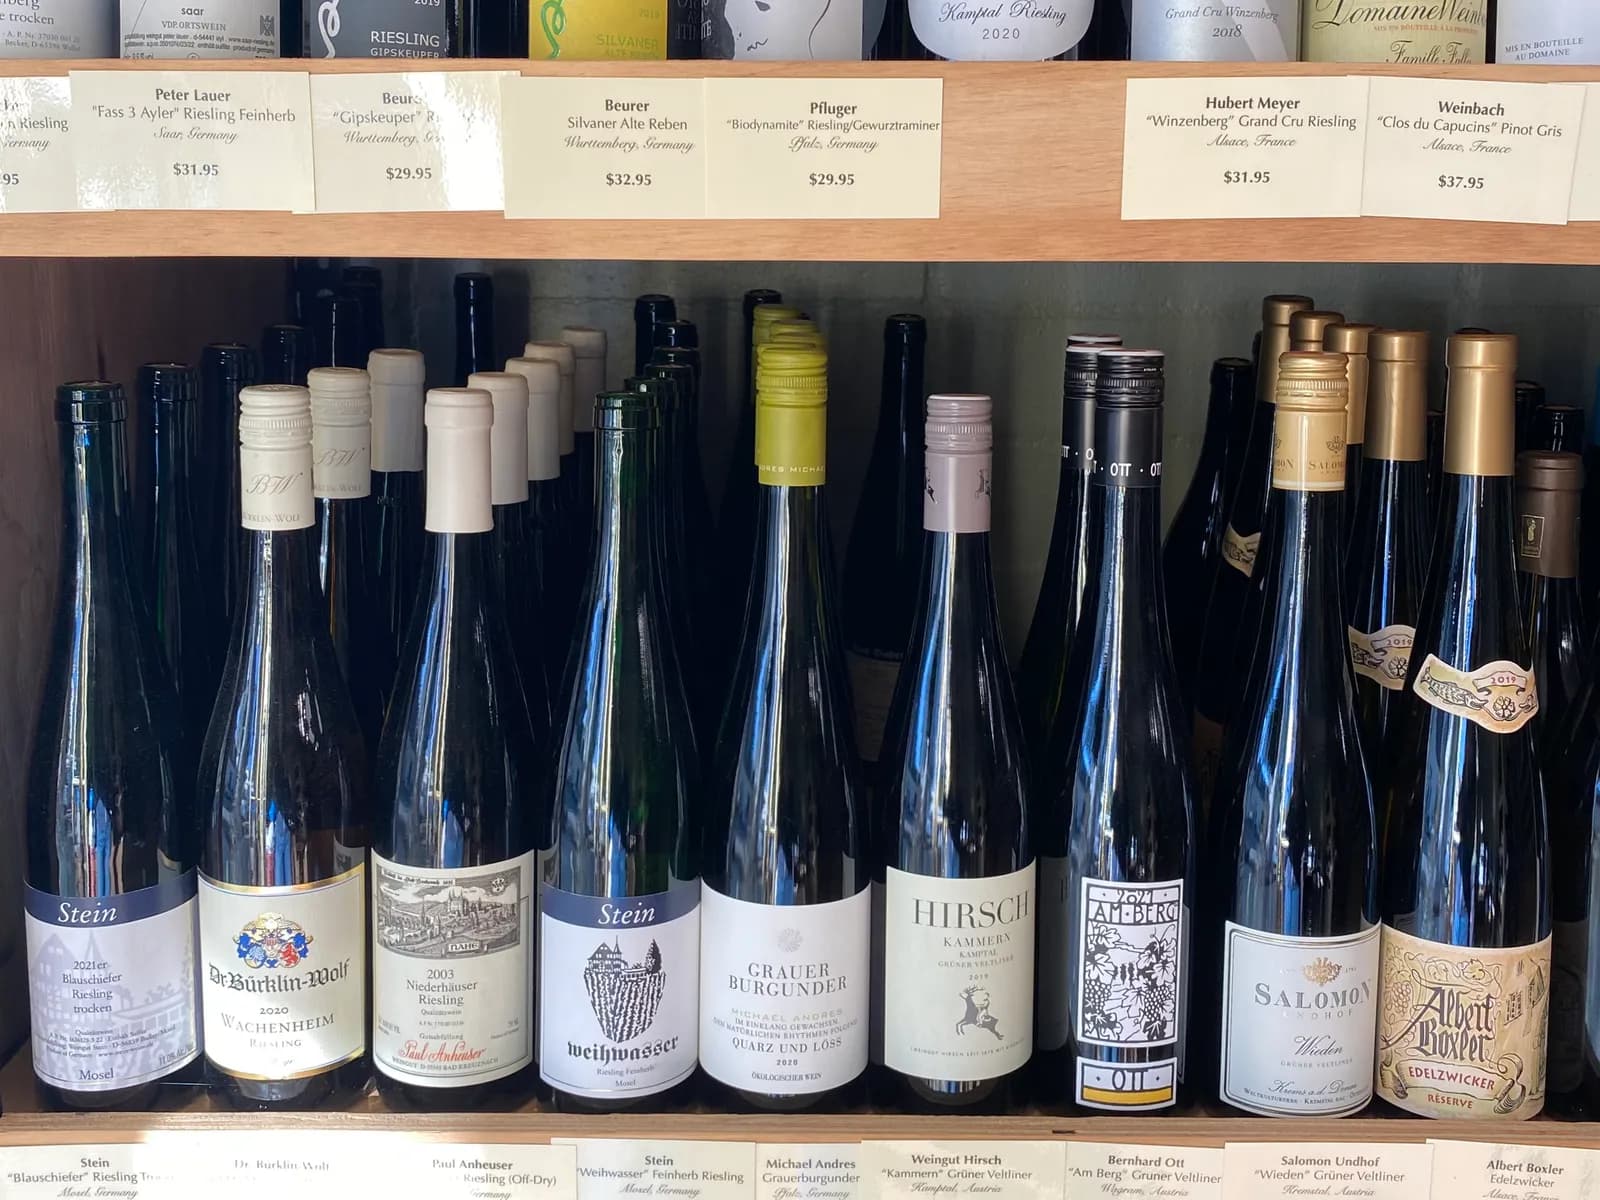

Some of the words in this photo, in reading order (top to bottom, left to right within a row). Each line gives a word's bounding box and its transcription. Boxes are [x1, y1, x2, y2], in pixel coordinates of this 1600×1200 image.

[10, 12, 54, 24] trocken
[181, 7, 204, 16] saar
[938, 1, 1003, 24] Kamptal
[1009, 0, 1066, 27] Riesling
[1165, 6, 1200, 19] Grand
[1202, 6, 1222, 17] Cru
[1225, 6, 1279, 24] Winzenberg
[1312, 0, 1439, 30] Domaine
[982, 28, 1020, 40] 2020
[1212, 24, 1242, 38] 2018
[370, 31, 440, 47] RIESLING
[595, 33, 658, 50] SILVANER
[1505, 44, 1518, 53] MIS
[1520, 42, 1532, 51] EN
[1534, 38, 1584, 49] BOUTEILLE
[1528, 48, 1570, 60] DOMAINE
[156, 88, 189, 101] Peter
[194, 89, 231, 102] Lauer
[605, 99, 650, 112] Beurer
[810, 102, 858, 118] Pfluger
[1206, 96, 1253, 110] Hubert
[1258, 97, 1301, 113] Meyer
[1438, 100, 1505, 116] Weinbach
[92, 106, 124, 118] "Fass
[128, 106, 136, 118] 3
[140, 106, 179, 122] Ayler"
[184, 107, 235, 124] Riesling
[240, 108, 296, 122] Feinherb
[333, 110, 421, 127] “Gipskeuper”
[567, 116, 617, 129] Silvaner
[620, 117, 645, 130] Alte
[649, 117, 688, 130] Reben
[726, 119, 804, 132] “Biodynamite”
[807, 120, 940, 134] Riesling/Gewurztraminer
[1146, 115, 1234, 130] “Winzenberg”
[1238, 115, 1278, 128] Grand
[1281, 115, 1304, 128] Cru
[1308, 115, 1357, 131] Riesling
[1377, 116, 1410, 129] “Clos
[1414, 118, 1430, 130] du
[1434, 119, 1498, 134] Capucins”
[1500, 122, 1533, 136] Pinot
[1536, 124, 1562, 138] Gris
[187, 127, 238, 144] Germany
[1206, 134, 1250, 148] Alsace,
[1254, 134, 1297, 147] France
[643, 136, 695, 154] Germany
[826, 136, 878, 153] Germany
[1422, 138, 1465, 152] Alsace,
[1469, 139, 1513, 154] France
[173, 162, 219, 176] $31.95
[386, 168, 432, 180] $29.95
[606, 172, 652, 186] $32.95
[809, 173, 855, 186] $29.95
[1224, 170, 1270, 184] $31.95
[1438, 174, 1484, 190] $37.95
[1110, 462, 1132, 477] OTT
[1386, 638, 1412, 647] 2019
[1490, 676, 1517, 686] 2019
[58, 902, 118, 924] Stein
[598, 902, 656, 924] Stein
[912, 890, 1030, 929] HIRSCH
[944, 933, 1010, 948] KAMMERN
[73, 960, 108, 970] 2021er
[748, 962, 830, 980] GRAUER
[62, 974, 122, 985] Blauschiefer
[427, 968, 455, 980] 2003
[406, 980, 478, 992] Niederhäuser
[728, 974, 848, 997] BURGUNDER
[72, 989, 113, 1000] Riesling
[418, 994, 464, 1006] Riesling
[1255, 980, 1370, 1010] SALOMON
[73, 1004, 112, 1014] trocken
[260, 1006, 289, 1015] 2020
[732, 1008, 786, 1022] MICHAEL
[792, 1008, 844, 1022] ANDRES
[221, 1013, 334, 1034] WACHENHEIM
[736, 1018, 746, 1026] IM
[790, 1018, 838, 1030] GEWACHSEN
[732, 1037, 774, 1053] QUARZ
[780, 1044, 808, 1054] UND
[813, 1037, 842, 1052] LÖSS
[1293, 1036, 1344, 1056] Wieden
[1412, 1018, 1495, 1063] Boxler
[398, 1040, 429, 1060] Paul
[568, 1036, 679, 1066] weihwasser
[79, 1068, 114, 1080] Mosel
[597, 1068, 624, 1077] Riesling
[804, 1072, 822, 1081] WEIN
[1112, 1068, 1148, 1091] OTT
[1408, 1066, 1495, 1091] EDELZWICKER
[80, 1157, 110, 1168] Stein
[432, 1160, 455, 1168] Paul
[459, 1160, 513, 1170] Anheuser
[644, 1155, 674, 1166] Stein
[766, 1158, 812, 1169] Michael
[815, 1158, 856, 1169] Andres
[912, 1154, 960, 1167] Weingut
[964, 1154, 1002, 1166] Hirsch
[1108, 1154, 1162, 1167] Bernhard
[1164, 1157, 1185, 1168] Ott
[1280, 1156, 1331, 1166] Salomon
[1335, 1156, 1380, 1167] Undhof
[1486, 1160, 1522, 1172] Albert
[1526, 1162, 1564, 1175] Boxler
[92, 1172, 138, 1184] Riesling
[464, 1174, 506, 1186] Riesling
[508, 1174, 556, 1188] (Off-Dry)
[652, 1169, 698, 1181] Feinherb
[702, 1170, 744, 1184] Riesling
[762, 1172, 860, 1186] Grauerburgunder
[946, 1168, 985, 1180] Grüner
[988, 1168, 1032, 1180] Veltliner
[1174, 1171, 1222, 1184] Veltliner
[1314, 1170, 1354, 1181] Grüner
[1356, 1170, 1405, 1182] Veltliner
[1490, 1174, 1554, 1188] Edelzwicker
[94, 1186, 139, 1200] Germany
[656, 1184, 700, 1198] Germany
[962, 1183, 1003, 1193] Austria
[1334, 1186, 1376, 1197] Austria
